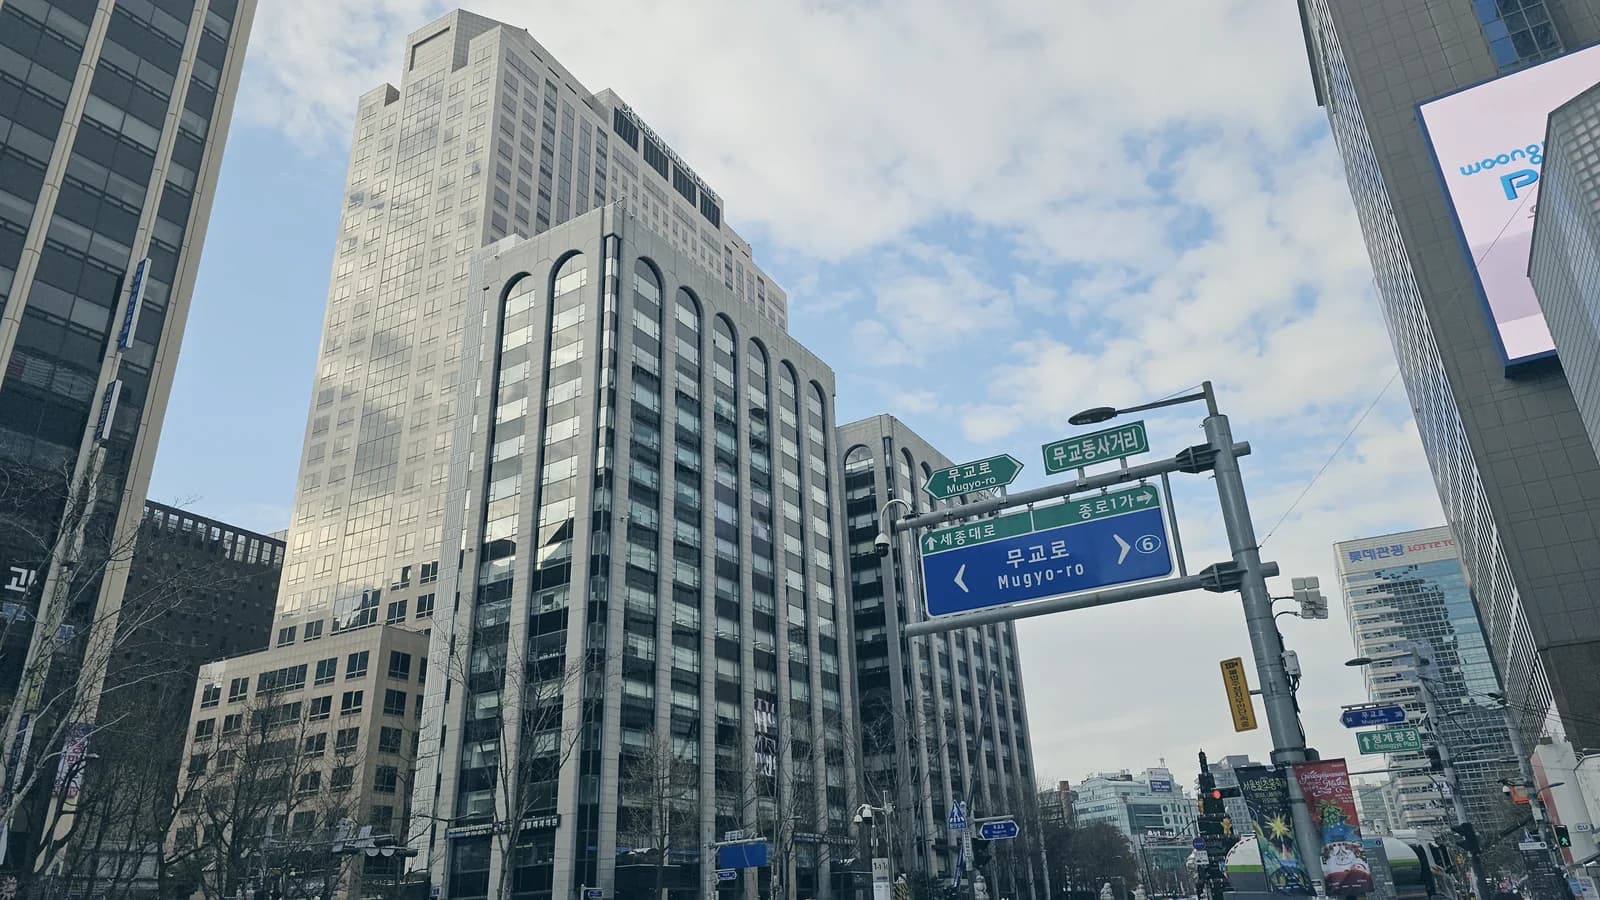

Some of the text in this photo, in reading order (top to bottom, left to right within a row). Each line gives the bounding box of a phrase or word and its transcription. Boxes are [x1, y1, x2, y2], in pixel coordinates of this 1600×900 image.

[638, 118, 664, 147] SEOUL
[1459, 141, 1545, 176] woong
[1053, 427, 1138, 466] 무교동사거리
[946, 475, 996, 494] Mugyo-ro
[947, 461, 993, 483] 무교로
[1079, 492, 1135, 519] 종로1가
[940, 523, 996, 547] 세종대로
[1141, 536, 1154, 552] 6
[1006, 540, 1070, 569] 무교로
[1349, 544, 1405, 563] 롯데관광
[1407, 540, 1442, 552] LOTTE
[997, 563, 1085, 591] Mugyo-ro
[1372, 731, 1417, 744] 청계광장
